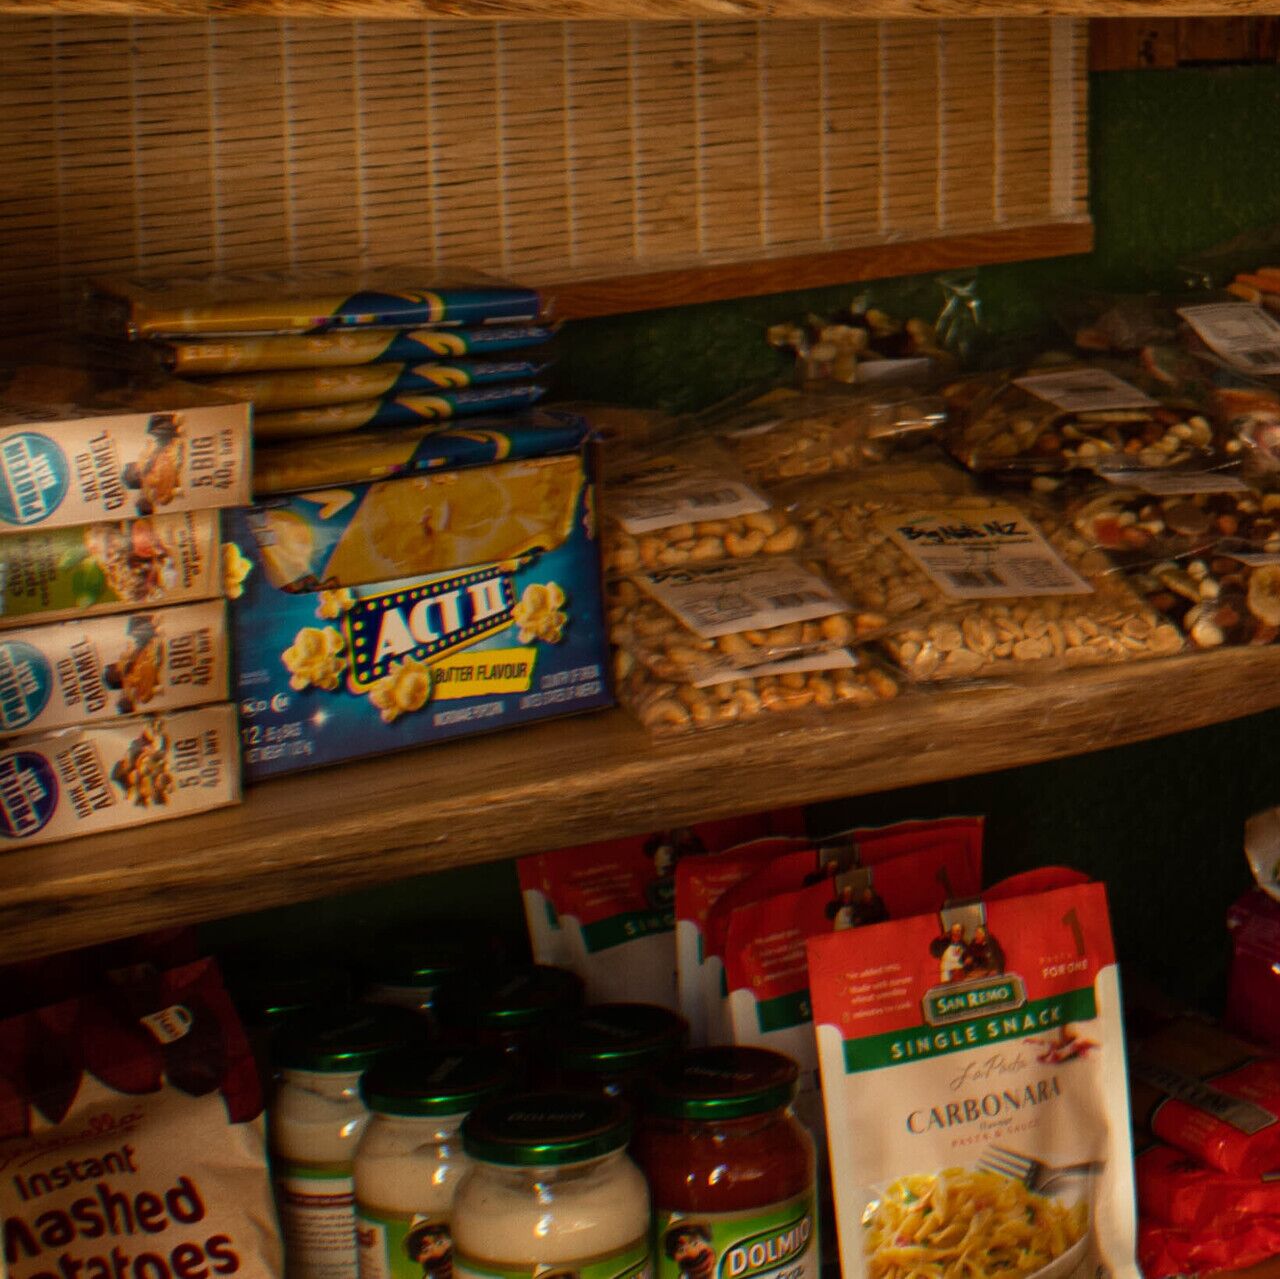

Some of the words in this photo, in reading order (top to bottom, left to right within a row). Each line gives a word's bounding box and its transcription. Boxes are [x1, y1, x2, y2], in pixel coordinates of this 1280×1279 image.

[75, 453, 100, 503] SALTED
[90, 430, 123, 511] CARAMEL
[377, 589, 461, 663] ACT
[70, 636, 105, 714] CARAMEL
[477, 662, 528, 680] FLAVOUR
[891, 1026, 977, 1062] SINGLE
[986, 1005, 1062, 1040] SNACK
[15, 1144, 136, 1201] Instant
